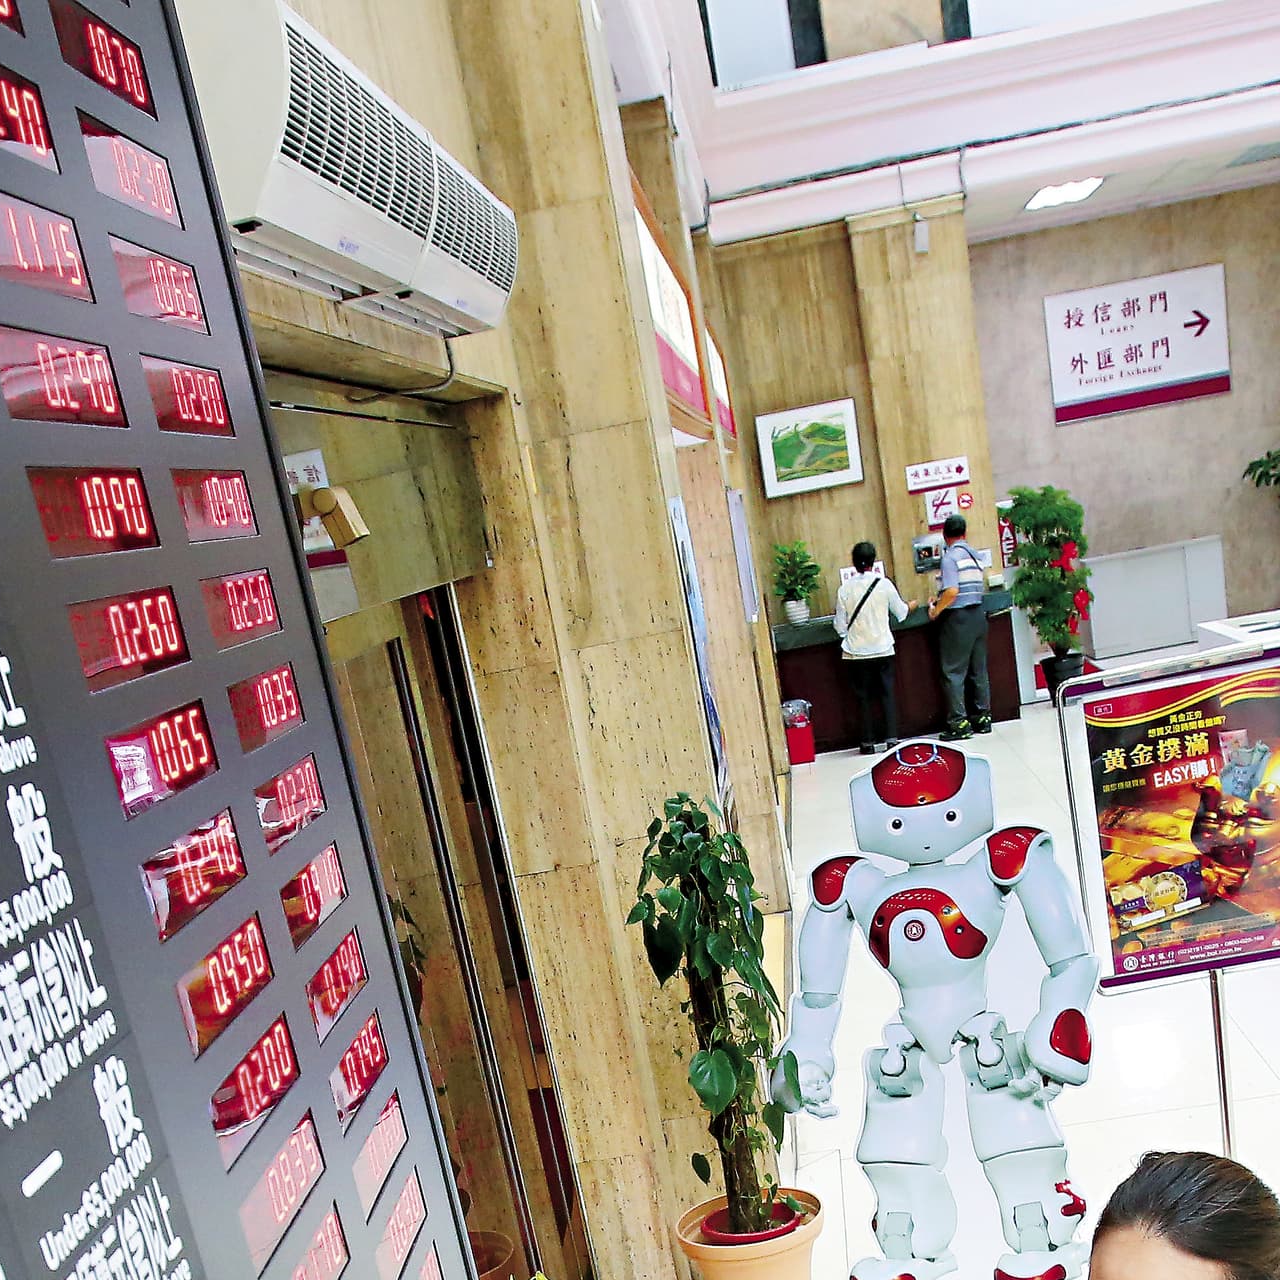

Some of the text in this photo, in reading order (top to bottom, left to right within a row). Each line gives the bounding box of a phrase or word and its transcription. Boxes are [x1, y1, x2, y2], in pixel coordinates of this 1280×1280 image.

[1064, 291, 1168, 329] 授信部門
[1070, 337, 1170, 375] 外匯部門
[1102, 732, 1209, 774] 黃金撲滿
[83, 1009, 117, 1055] above
